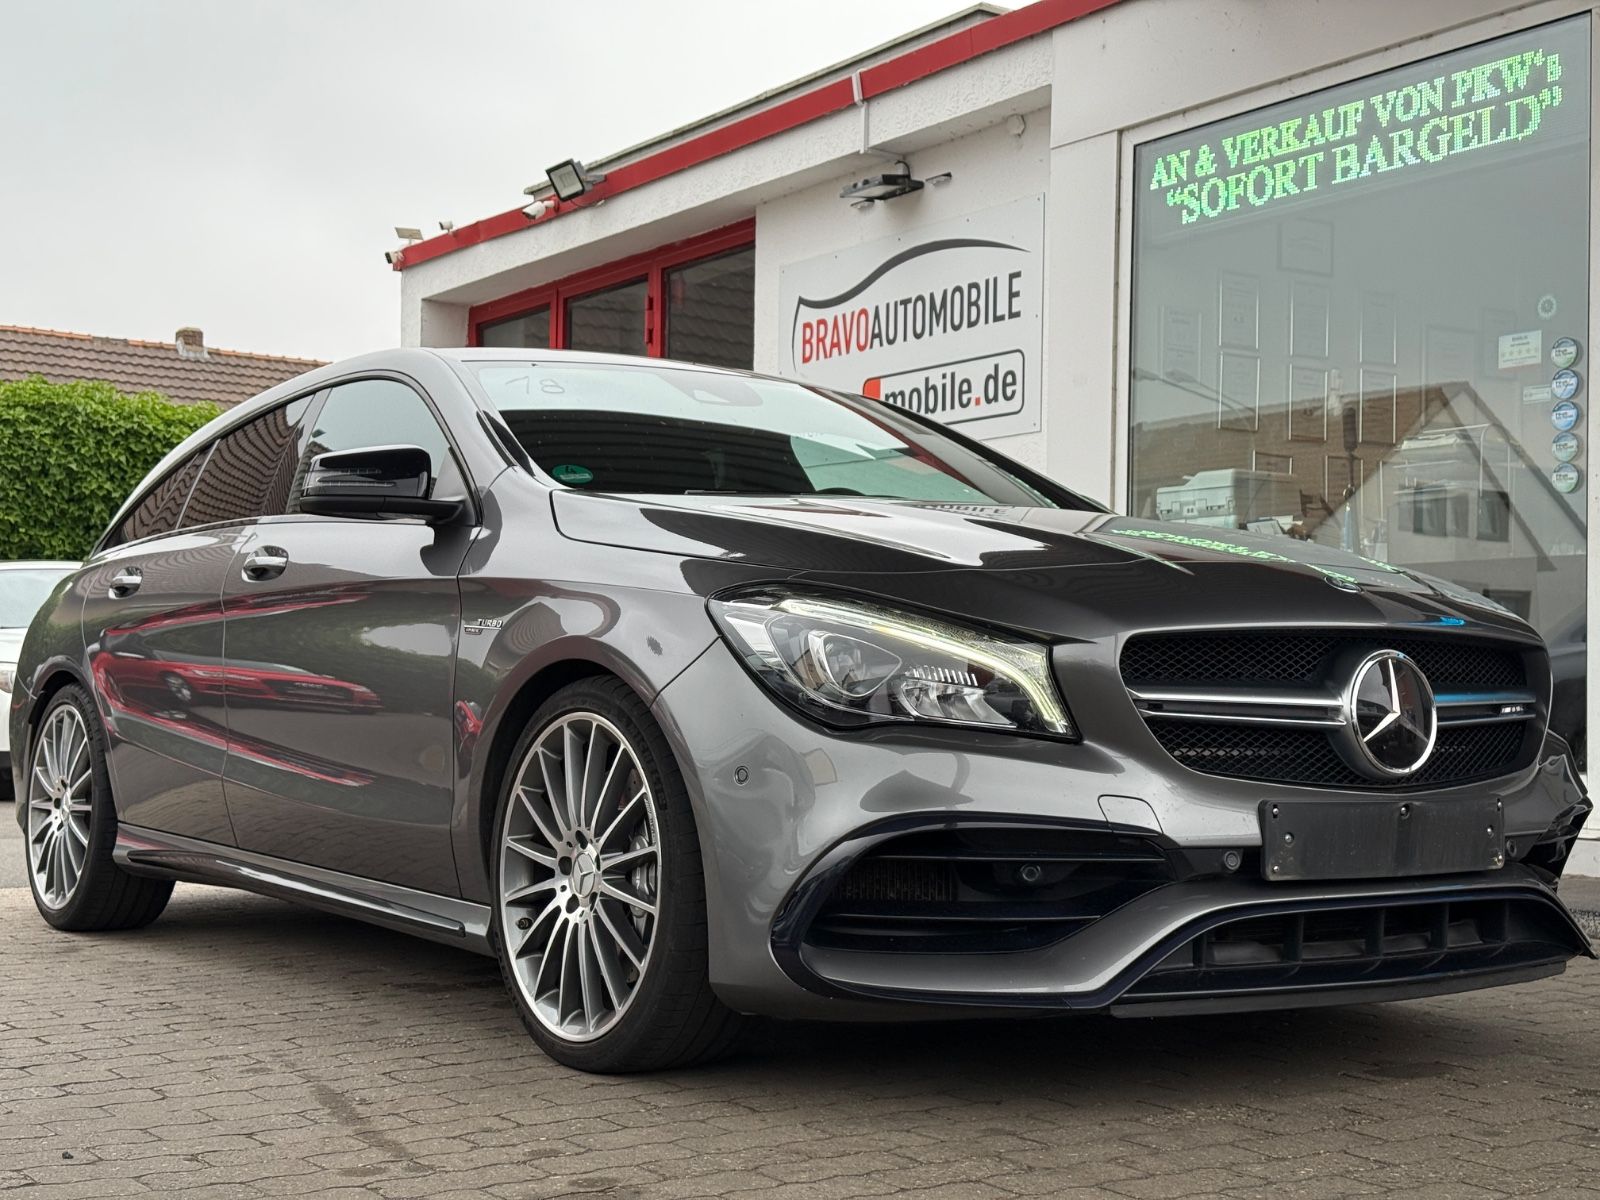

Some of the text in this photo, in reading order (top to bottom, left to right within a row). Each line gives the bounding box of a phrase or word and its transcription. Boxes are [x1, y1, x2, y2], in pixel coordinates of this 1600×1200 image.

[1150, 149, 1191, 190] AN
[1195, 144, 1218, 178] &
[1222, 100, 1365, 168] VERKAUF
[1370, 76, 1445, 128] VON
[801, 270, 1022, 364] BRAVOAUTOMOBILE
[477, 618, 503, 629] TURBO
